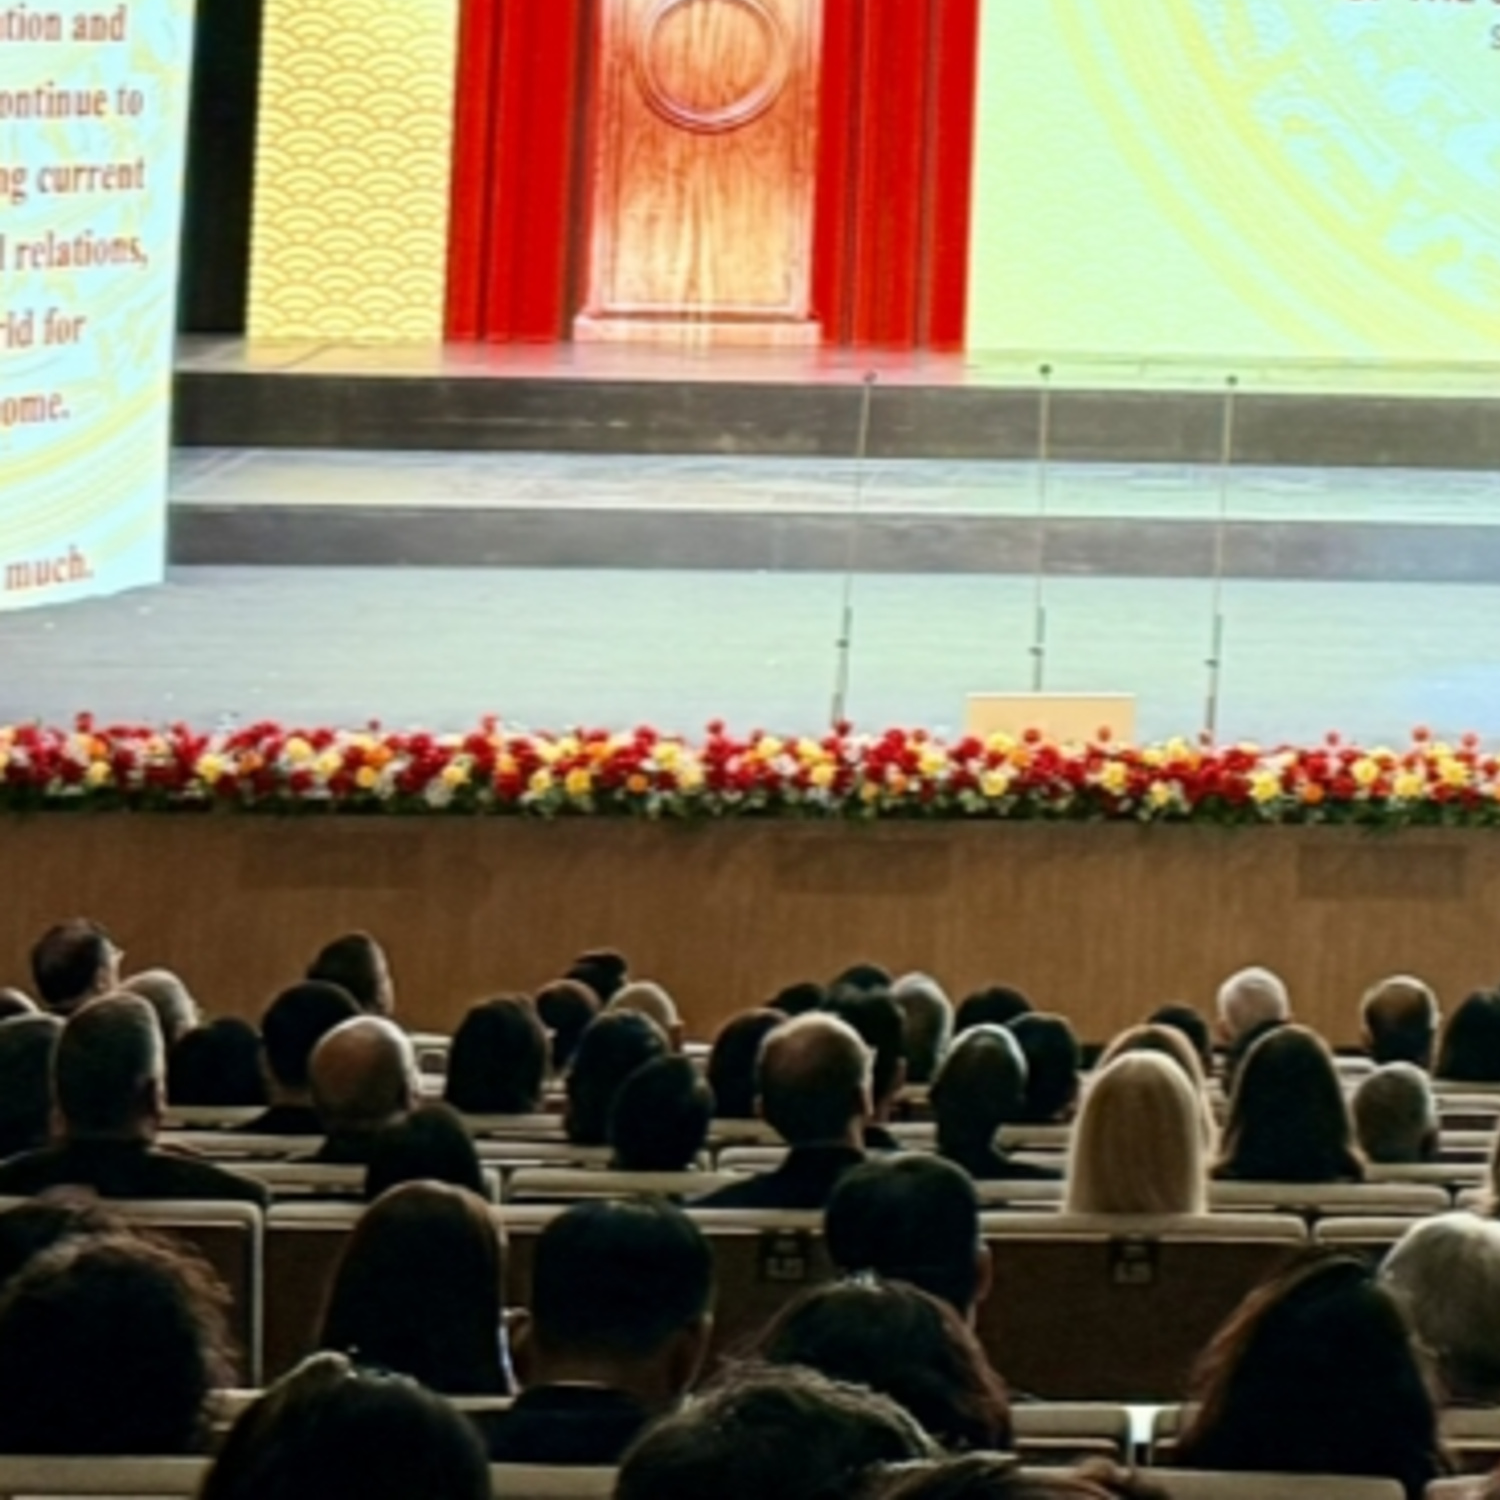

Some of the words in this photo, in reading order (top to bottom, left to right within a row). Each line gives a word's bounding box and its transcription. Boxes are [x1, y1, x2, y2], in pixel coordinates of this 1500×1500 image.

[73, 3, 127, 42] and
[117, 85, 144, 116] to
[37, 156, 145, 193] current
[16, 229, 149, 270] relations,
[45, 306, 87, 345] for
[5, 543, 93, 591] much.
